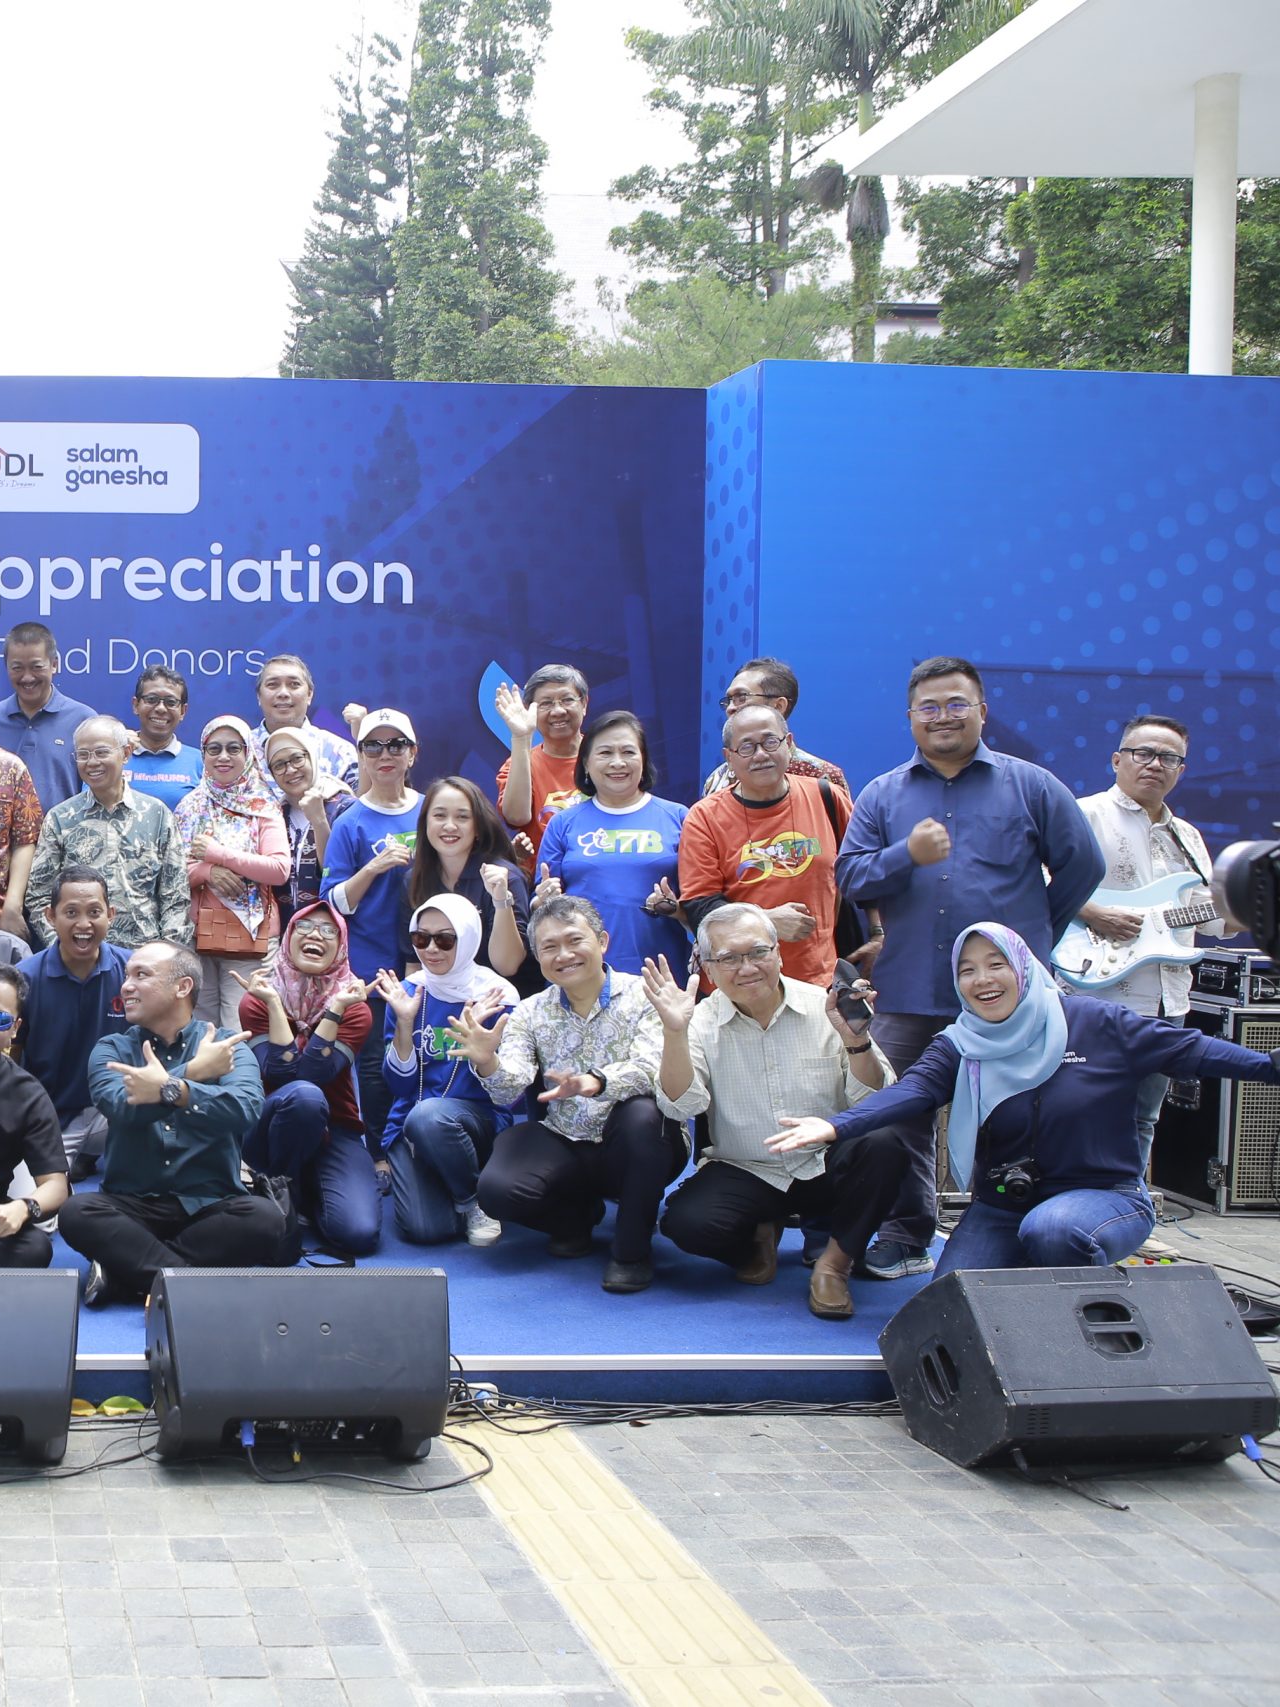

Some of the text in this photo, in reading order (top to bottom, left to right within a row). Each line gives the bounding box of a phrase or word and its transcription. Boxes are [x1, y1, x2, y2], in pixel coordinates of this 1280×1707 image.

[67, 443, 139, 463] salam
[65, 465, 169, 492] ganesha
[108, 638, 266, 677] Donors
